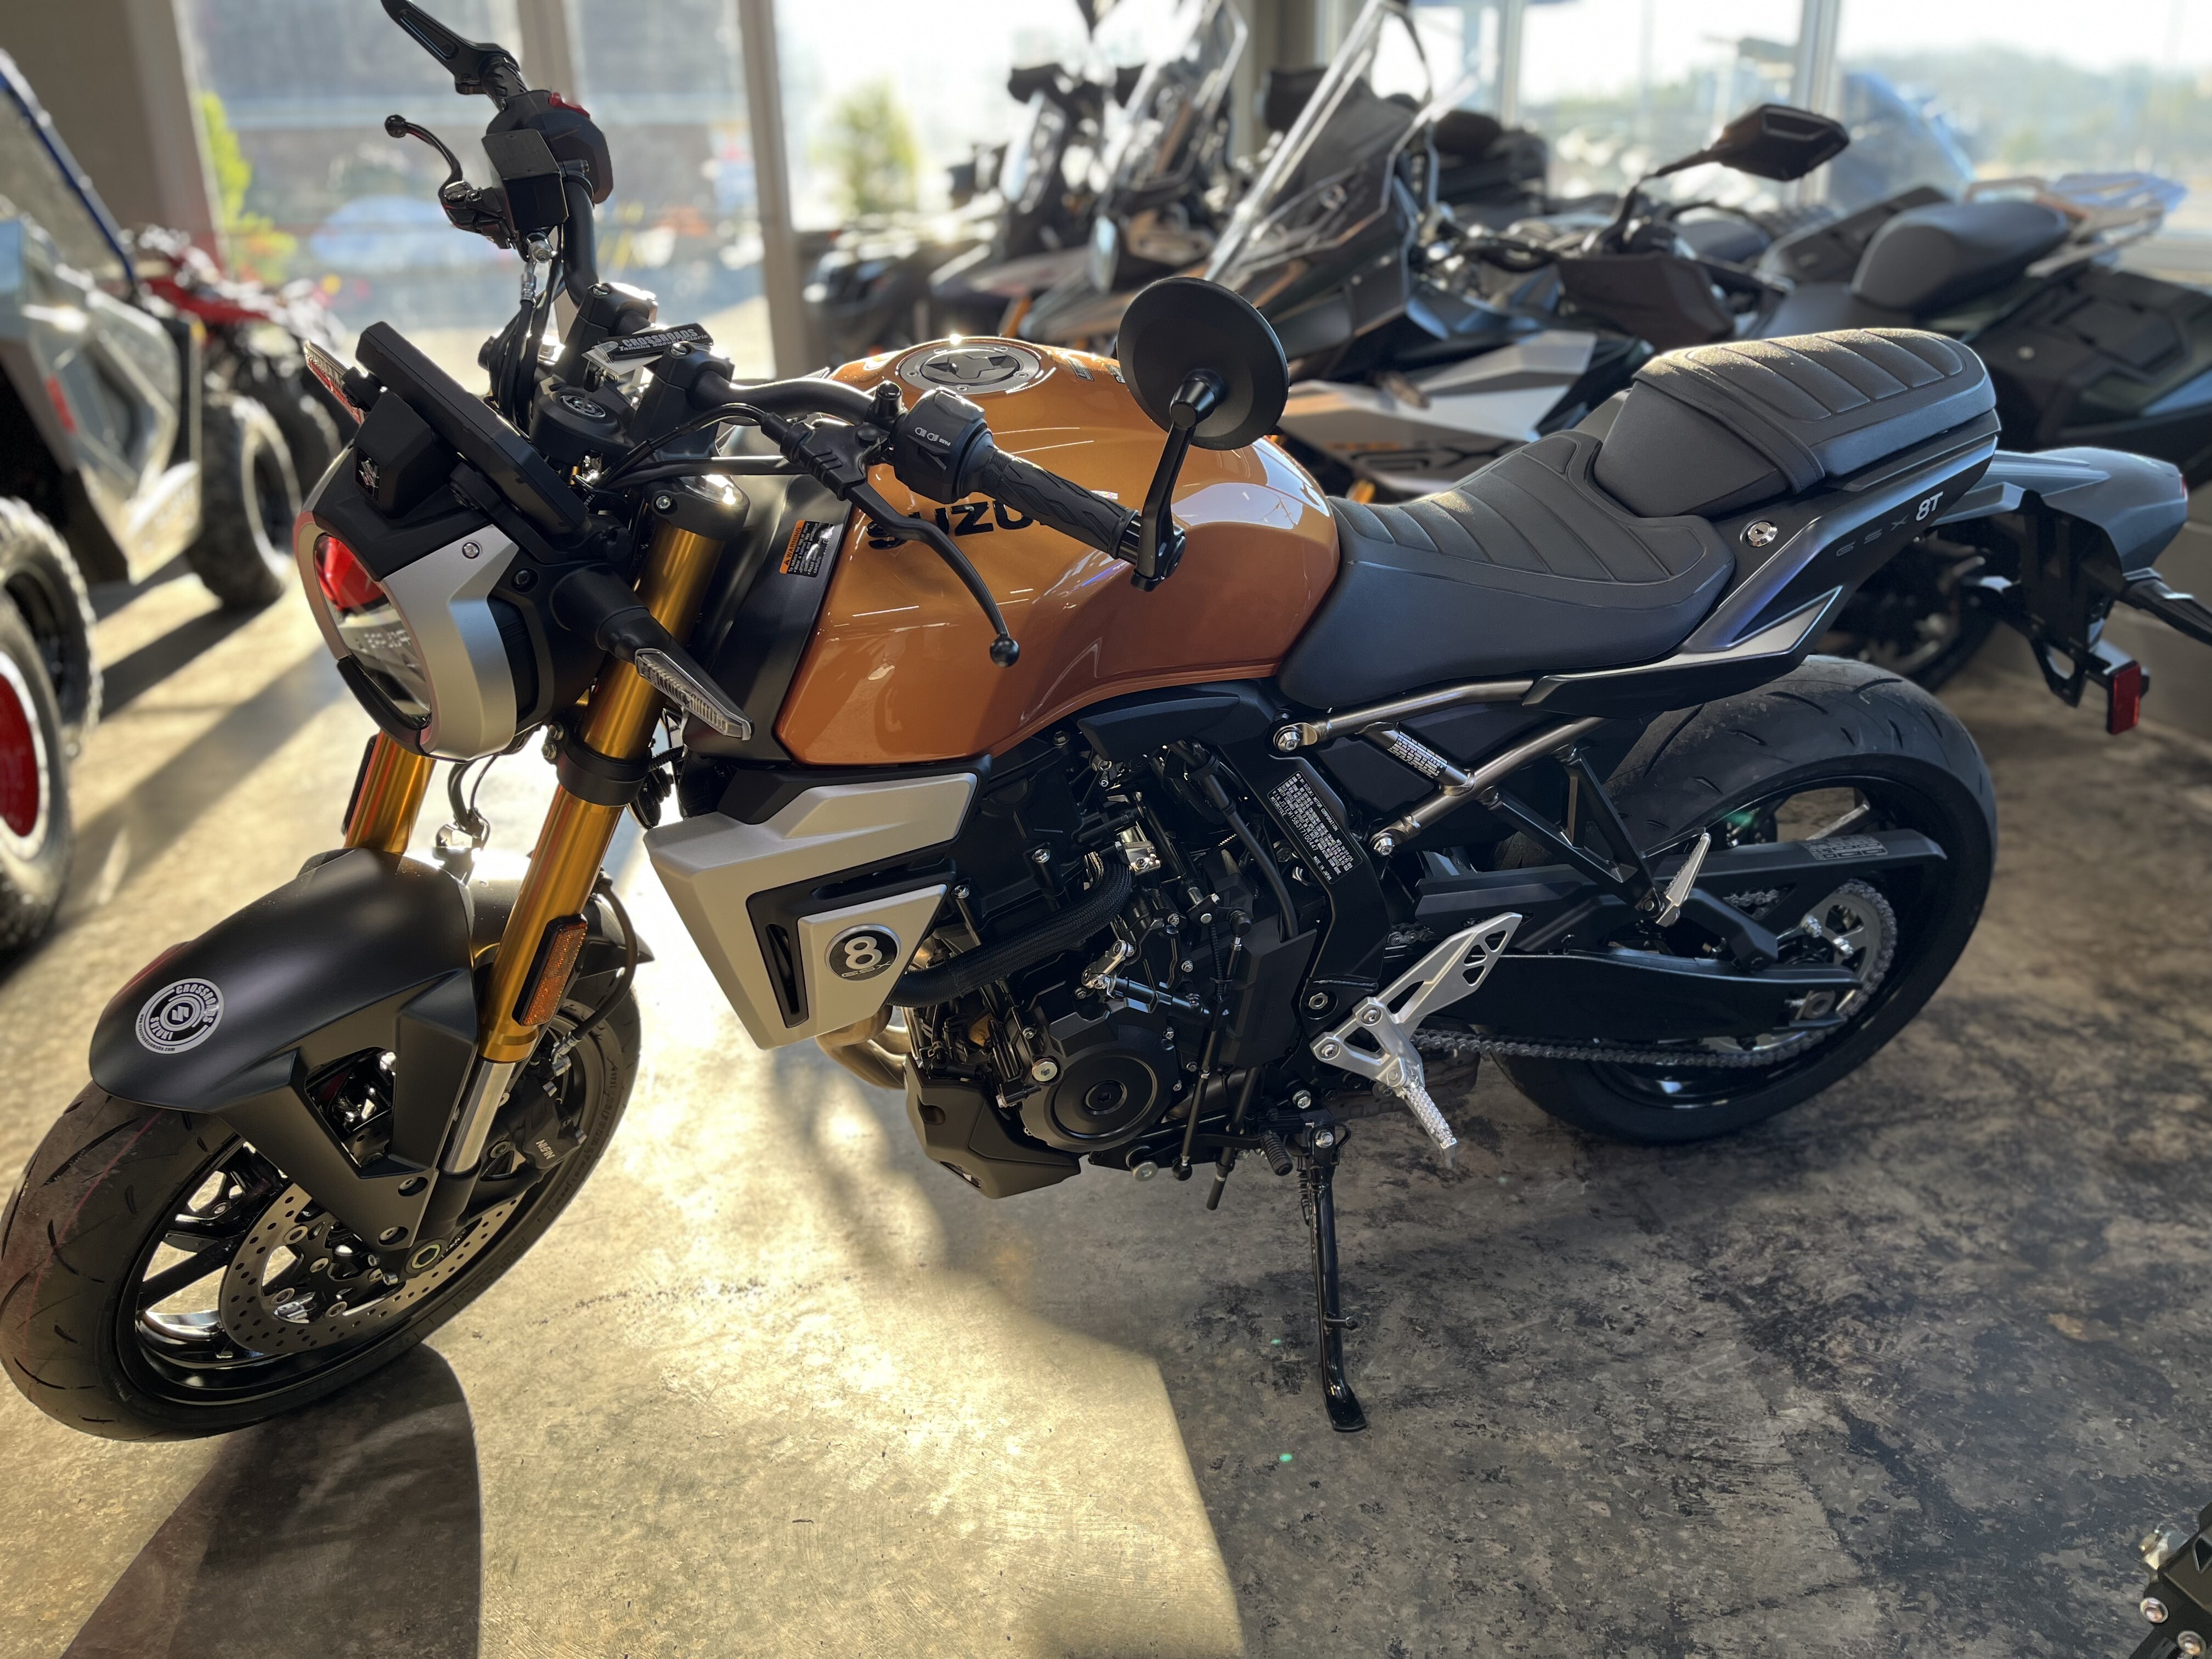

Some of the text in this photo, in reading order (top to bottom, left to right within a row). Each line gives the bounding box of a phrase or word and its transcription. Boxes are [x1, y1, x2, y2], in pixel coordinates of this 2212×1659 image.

[622, 329, 698, 347] CROSSROADS
[1915, 491, 1944, 522] 8T
[786, 527, 801, 557] WARNING
[844, 936, 883, 970] 8
[841, 960, 891, 978] GSX
[176, 983, 219, 1024] CROSSROADS
[150, 1016, 174, 1040] SUZUKI
